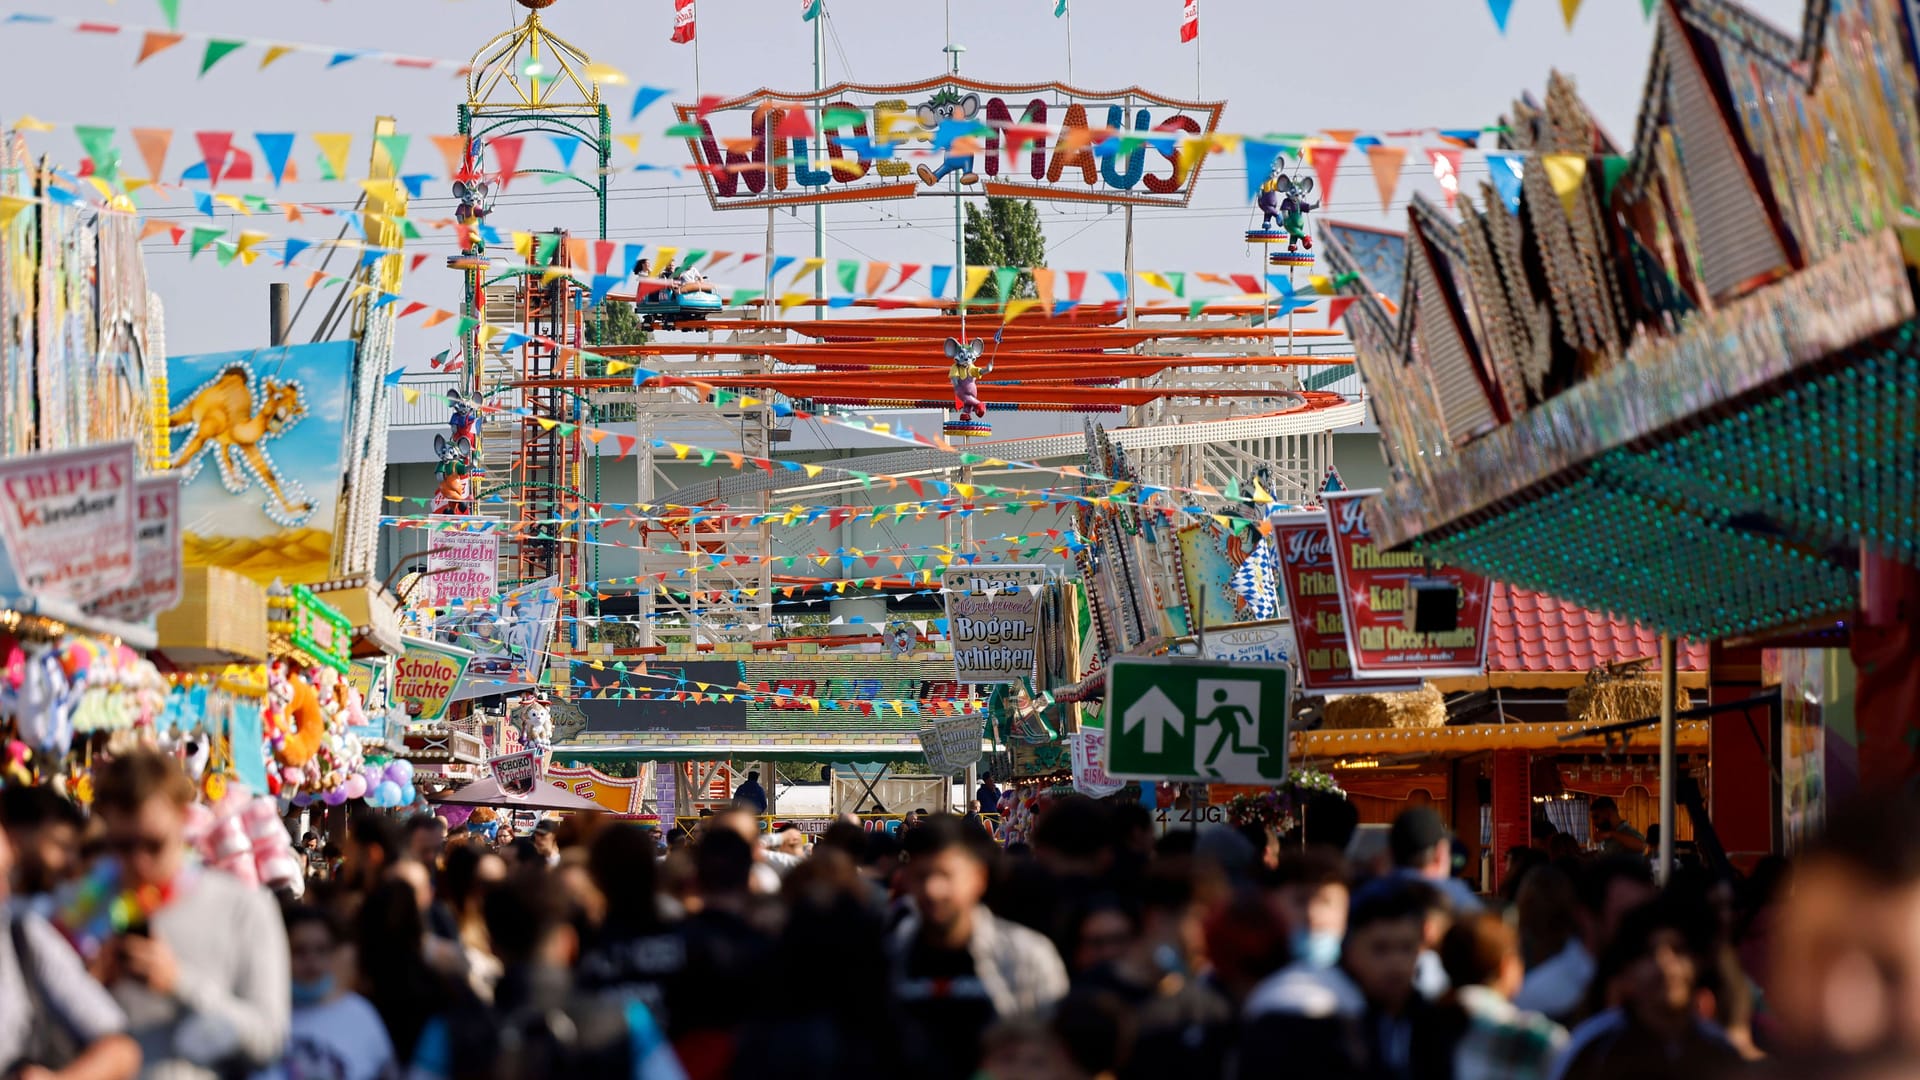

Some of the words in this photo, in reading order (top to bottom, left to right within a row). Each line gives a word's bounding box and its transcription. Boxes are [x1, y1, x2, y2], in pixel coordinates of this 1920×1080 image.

[696, 99, 912, 197] WILDE
[985, 97, 1201, 194] MAUS
[431, 542, 494, 562] Mandeln
[970, 577, 1018, 597] Das
[956, 616, 1034, 644] Bogen-
[394, 657, 457, 682] Schoko-
[394, 678, 451, 699] früchte
[497, 756, 530, 772] SCHOKO
[499, 768, 532, 785] Früchte
